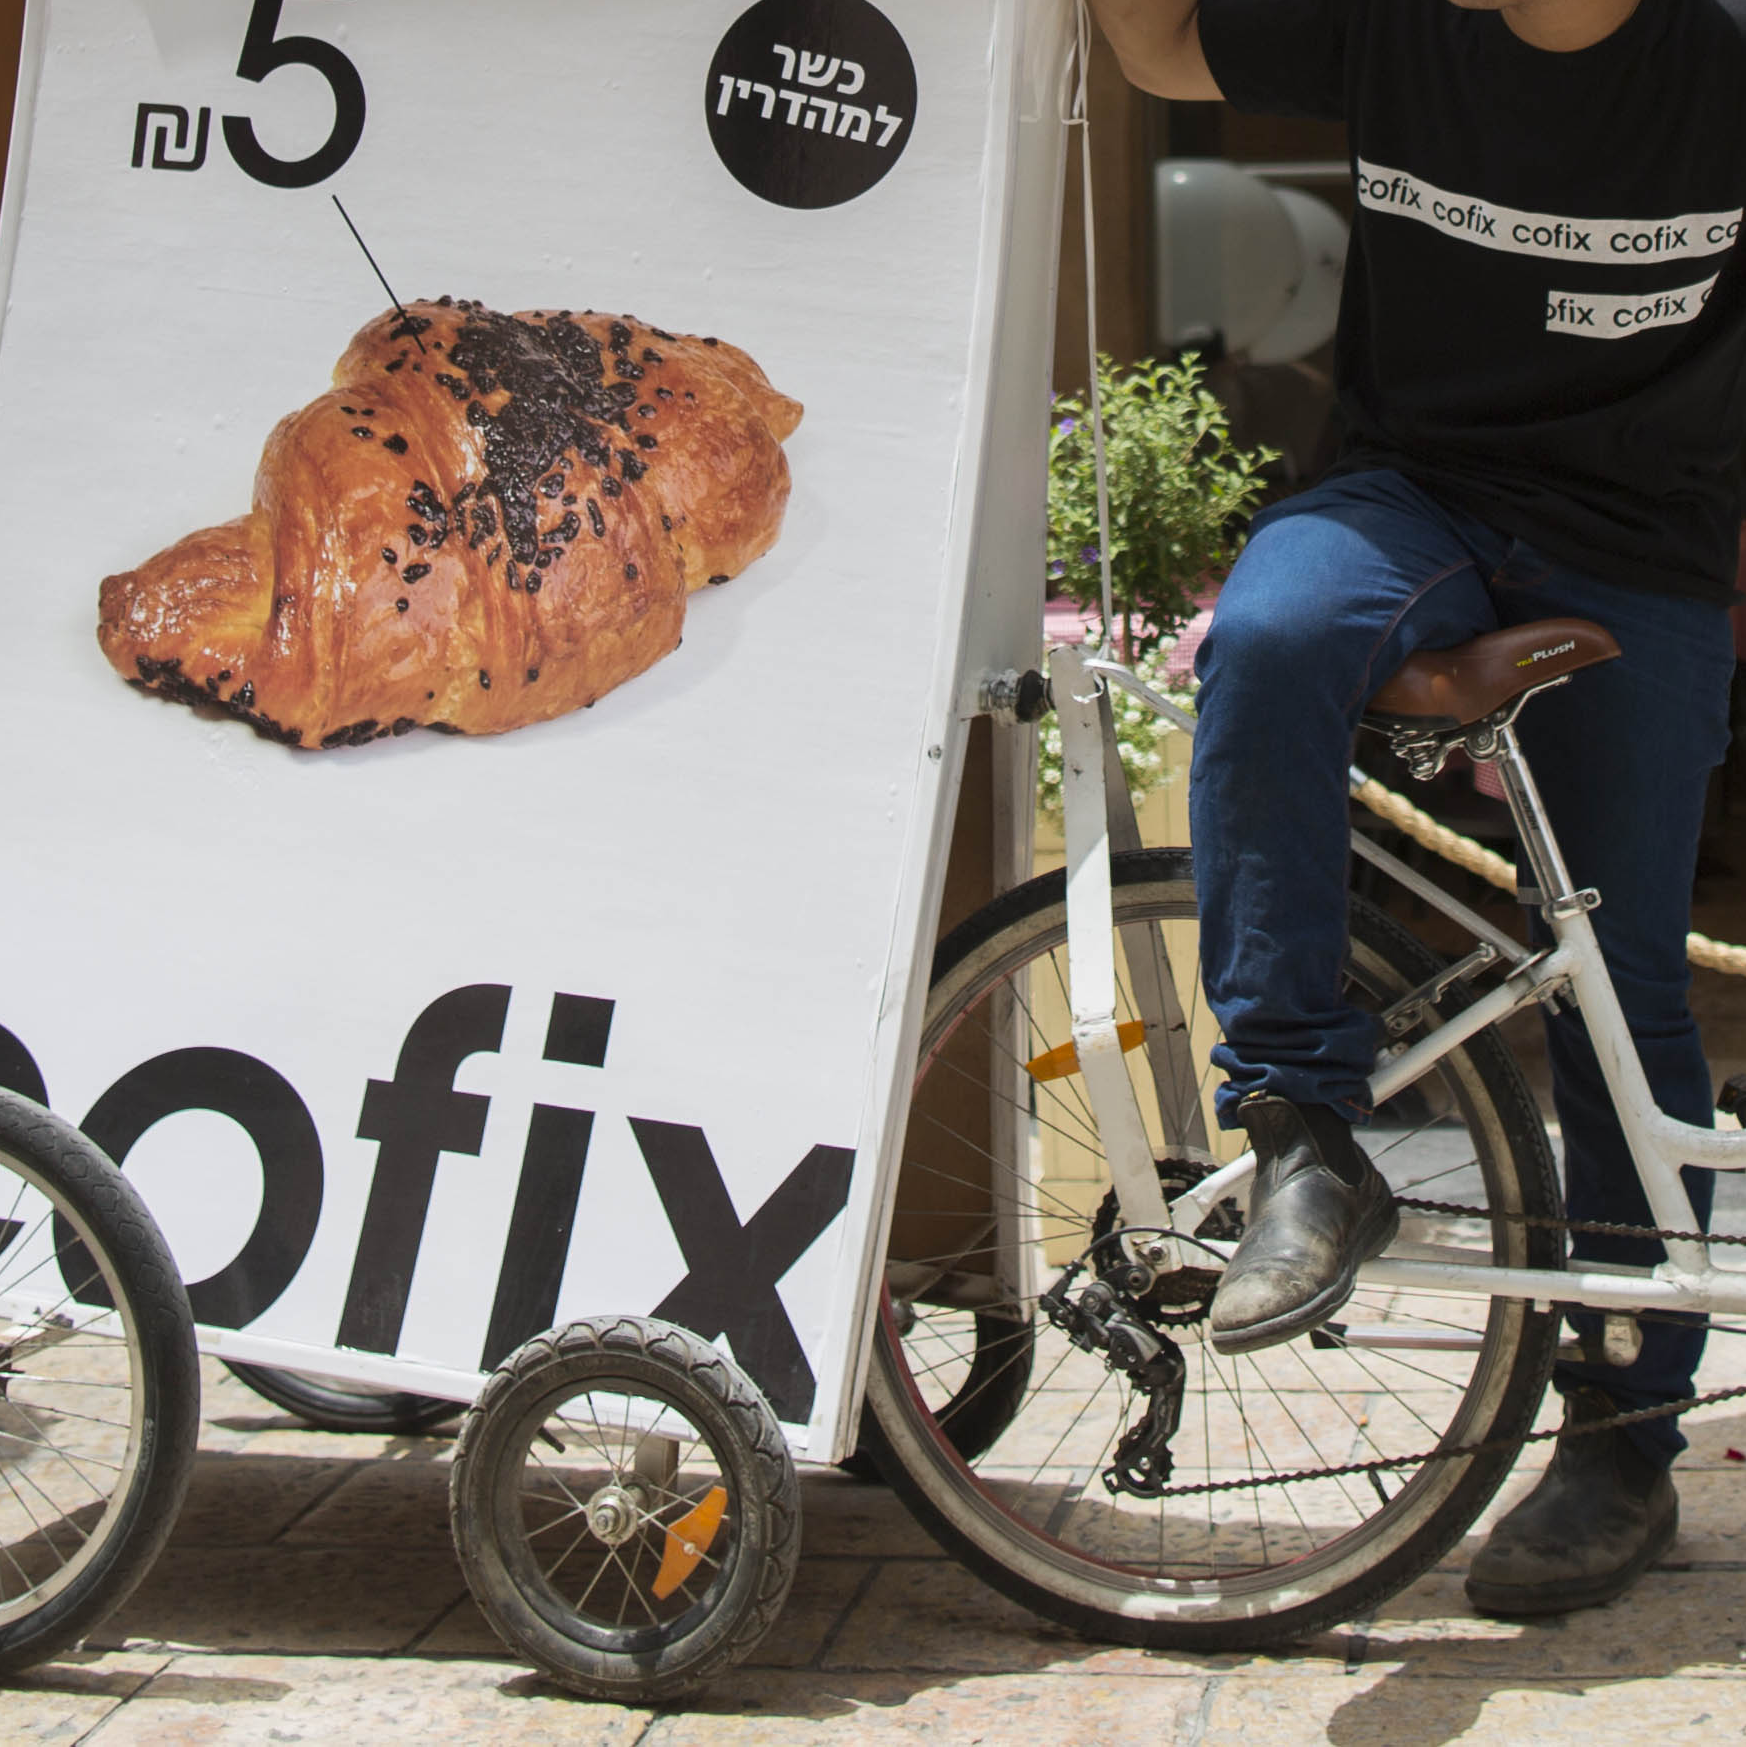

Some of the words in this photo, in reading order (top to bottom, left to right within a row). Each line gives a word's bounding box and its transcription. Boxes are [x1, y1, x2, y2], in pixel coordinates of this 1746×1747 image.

[772, 42, 866, 96] כשר
[716, 73, 904, 149] למהדרין
[1432, 200, 1496, 238] cofix
[1512, 221, 1592, 252] cofix
[1609, 225, 1689, 254] cofix
[1613, 296, 1687, 328] cofix
